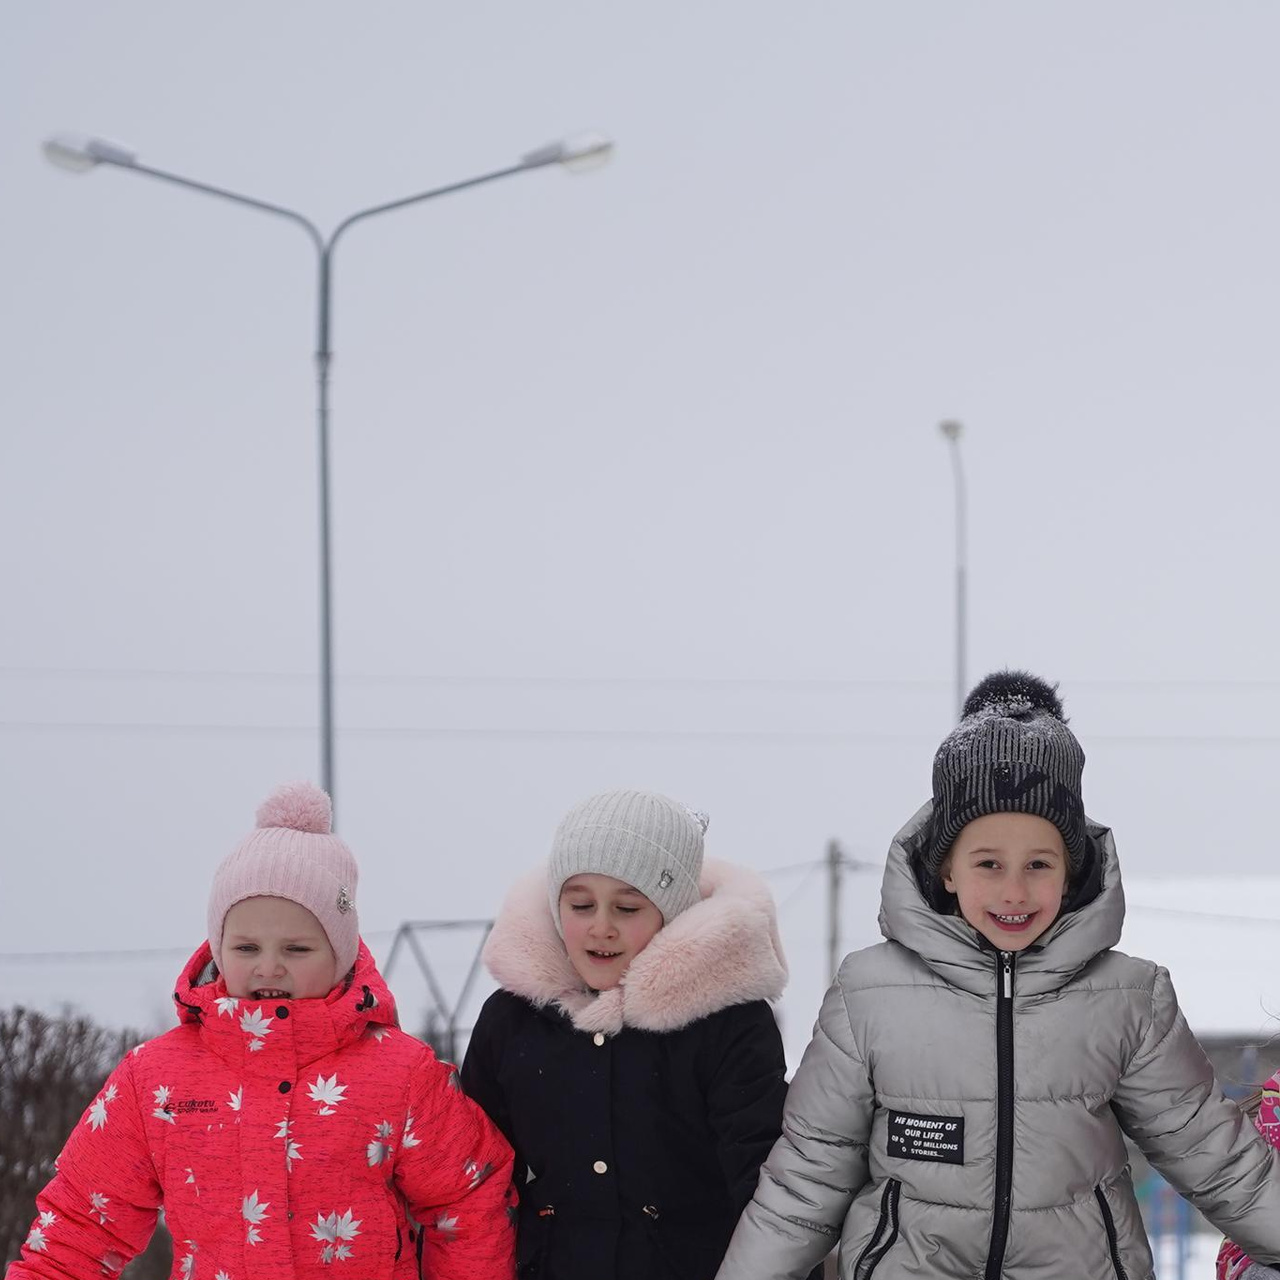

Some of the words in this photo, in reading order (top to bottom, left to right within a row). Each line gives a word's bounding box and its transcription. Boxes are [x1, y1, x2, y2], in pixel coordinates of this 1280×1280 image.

[906, 1118, 944, 1129] MOMENT
[945, 1123, 957, 1131] OF
[904, 1128, 921, 1138] OUR
[922, 1131, 944, 1140] LIFE?
[923, 1141, 958, 1150] MILLIONS
